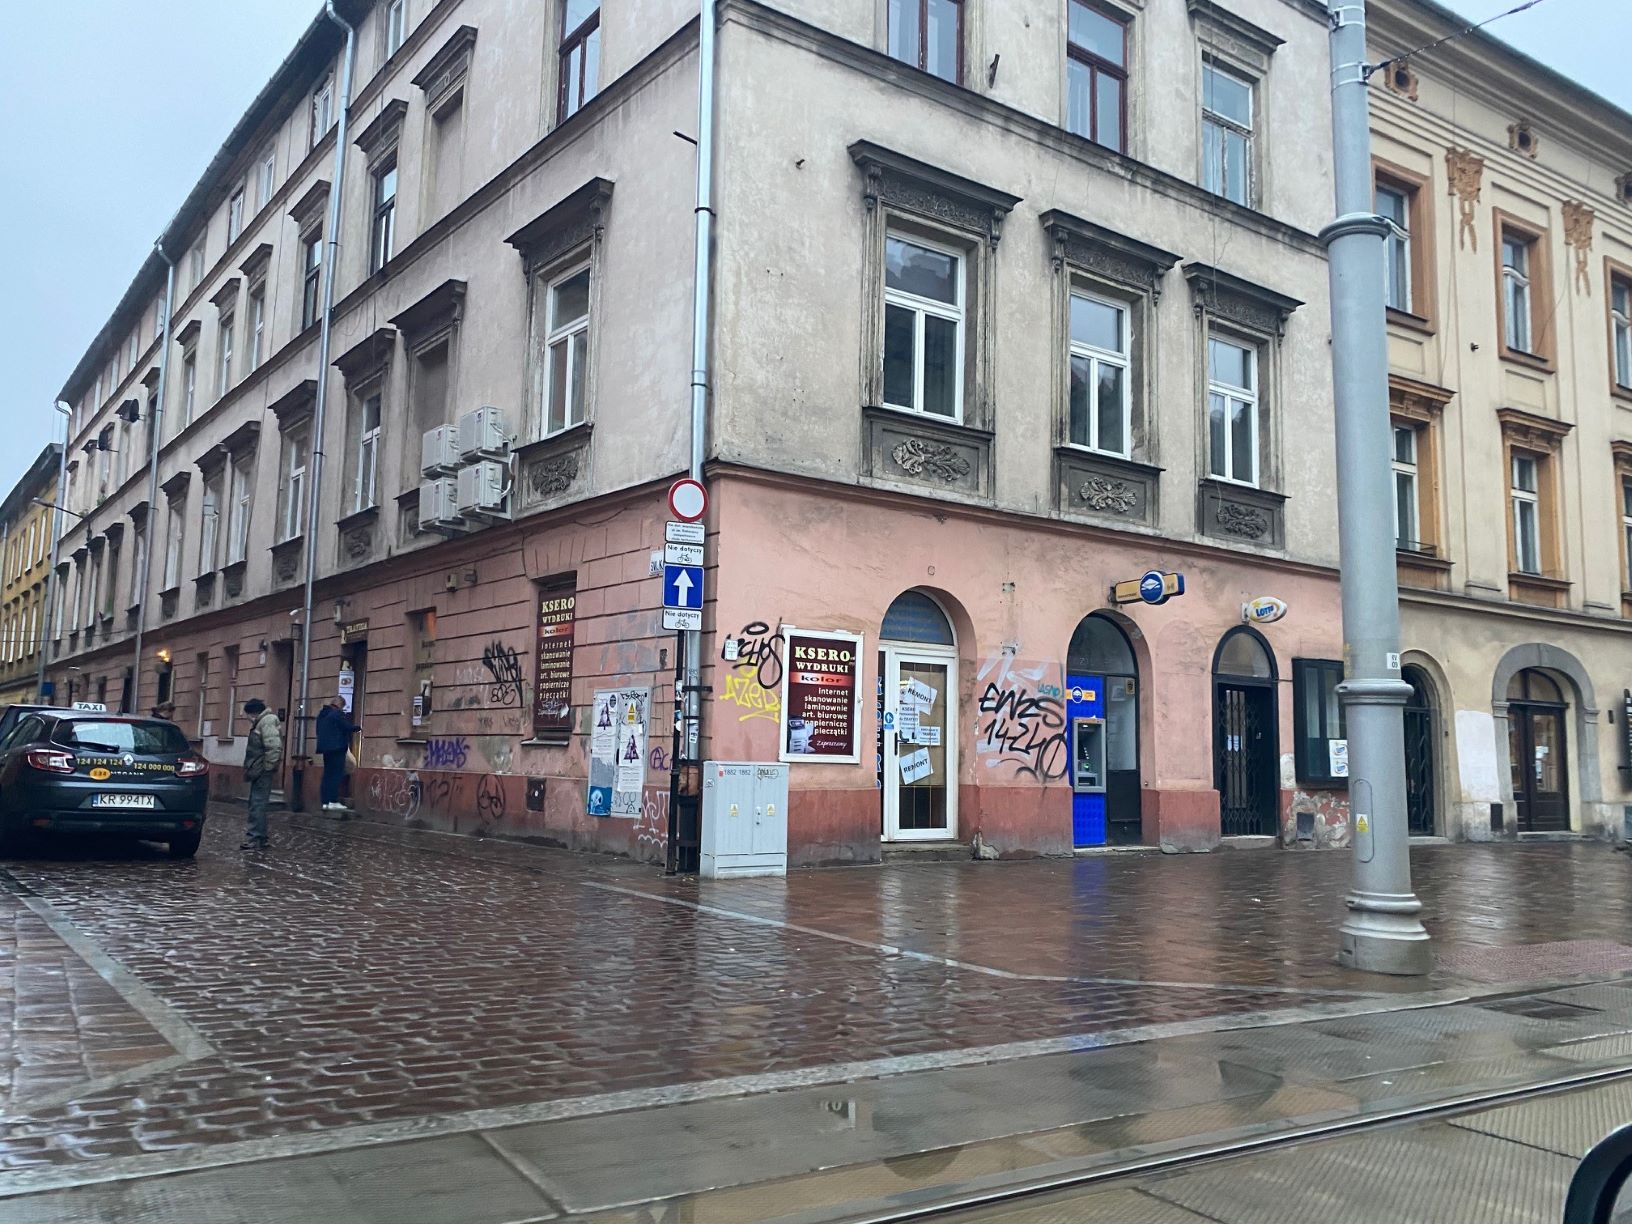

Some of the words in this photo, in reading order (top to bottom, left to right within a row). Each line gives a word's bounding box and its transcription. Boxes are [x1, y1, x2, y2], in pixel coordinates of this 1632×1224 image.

[680, 545, 703, 554] dotyczy
[542, 597, 575, 613] KSERO
[542, 612, 573, 624] WYDRUKI
[677, 610, 700, 619] dotyczy
[544, 627, 569, 635] kolor
[541, 640, 571, 650] internet
[541, 650, 571, 661] skanowanie
[795, 646, 851, 662] KSERO
[540, 660, 570, 670] laminowanie
[796, 661, 849, 673] WYDRUKI
[550, 670, 570, 679] biurowe
[801, 675, 842, 683] kolor
[540, 681, 570, 690] papiernicze
[818, 687, 849, 697] internet
[907, 687, 932, 704] REMONT
[804, 694, 849, 704] skanowanie
[78, 703, 103, 711] TAXI
[804, 703, 848, 712] laminownie
[817, 711, 848, 720] biurowe
[805, 719, 848, 728] papiernicze
[814, 727, 848, 737] pieczątki
[816, 740, 848, 750] Zapraszamy
[109, 758, 123, 766] 124
[133, 762, 147, 770] 124
[148, 763, 161, 771] 000
[903, 759, 928, 774] REMONT
[100, 795, 116, 804] KR
